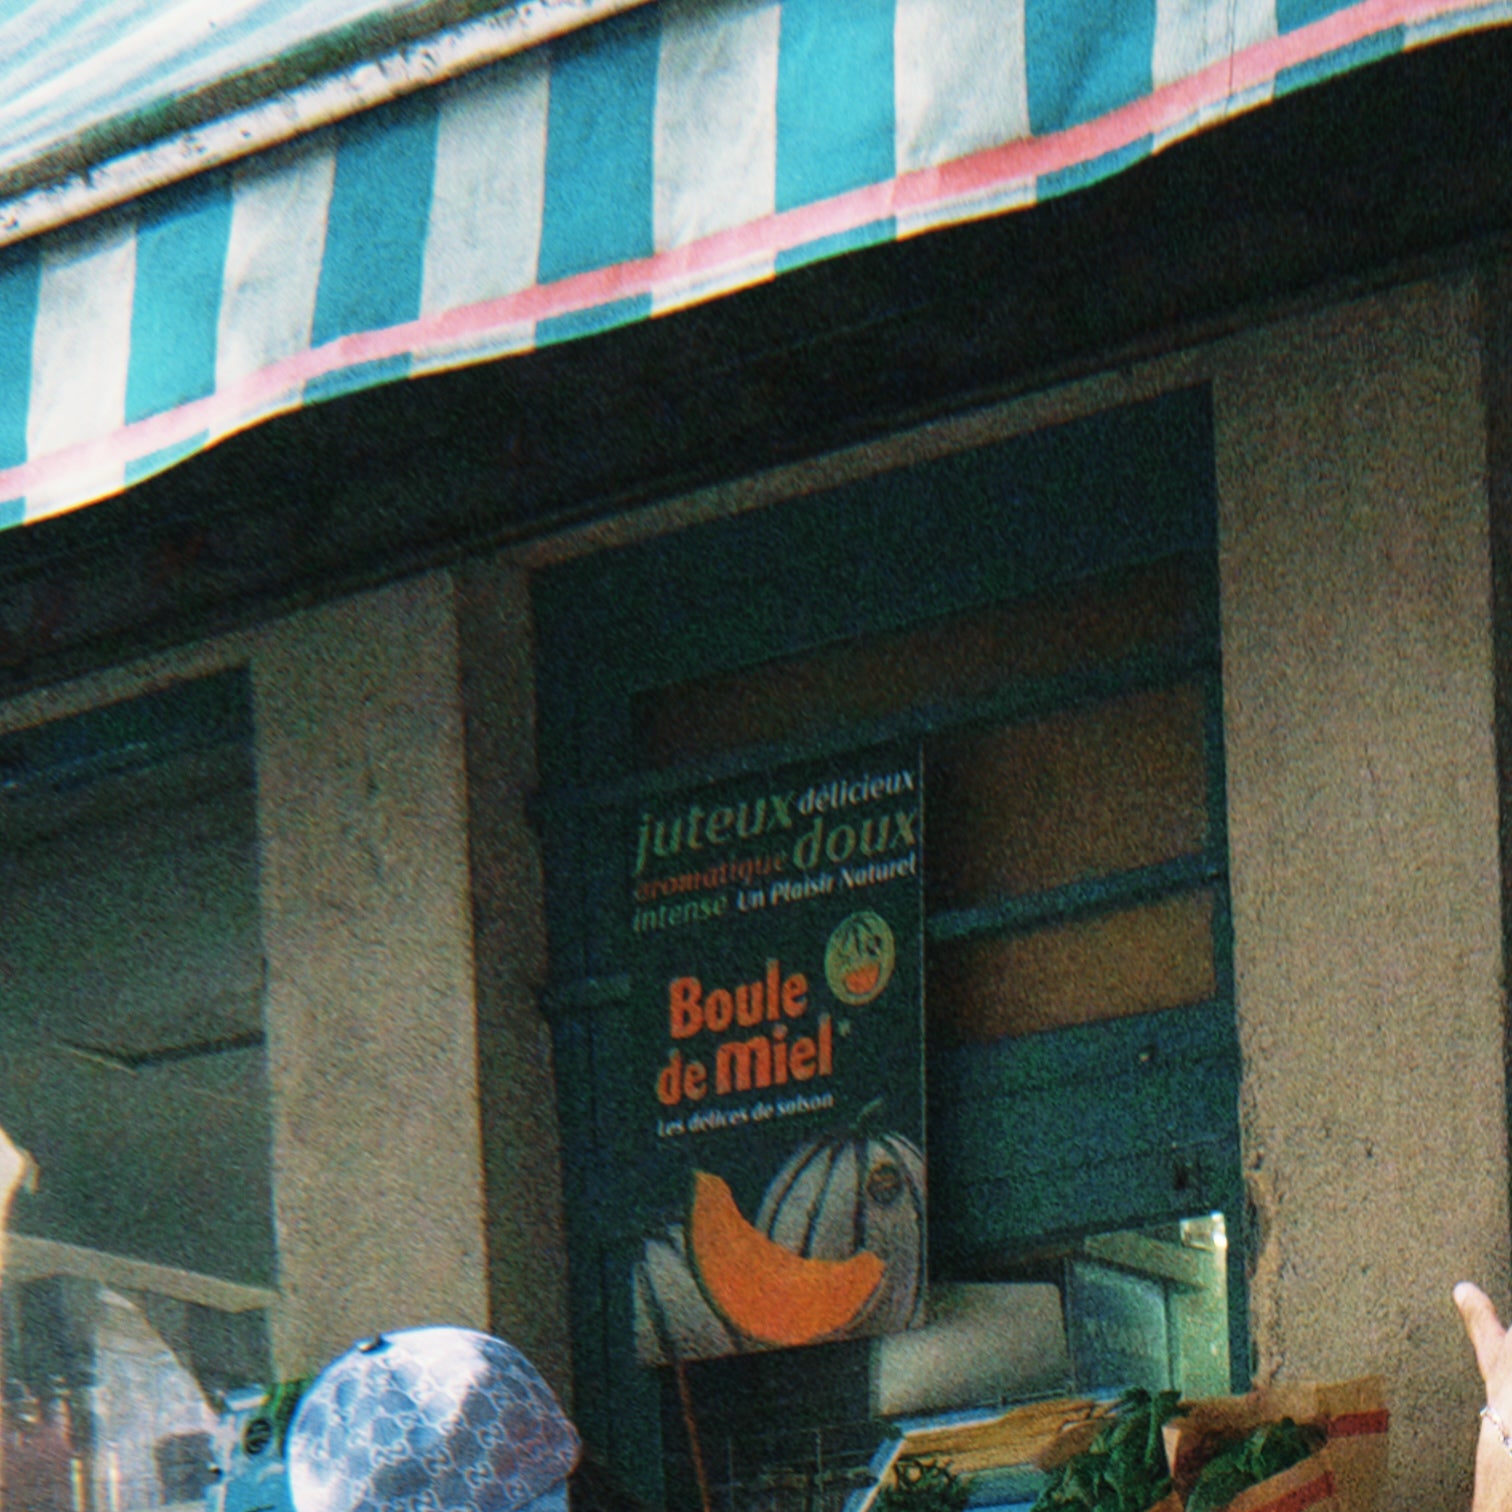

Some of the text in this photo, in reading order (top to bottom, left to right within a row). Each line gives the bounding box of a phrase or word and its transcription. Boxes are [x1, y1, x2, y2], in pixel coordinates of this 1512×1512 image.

[632, 769, 914, 877] juteux délicieux
[634, 808, 918, 901] aromatique doux
[632, 896, 728, 933] intense
[770, 872, 835, 905] Plaisir
[841, 851, 917, 888] Naturel
[669, 957, 808, 1039] Boule
[656, 1012, 832, 1105] de miel
[751, 1101, 774, 1121] de
